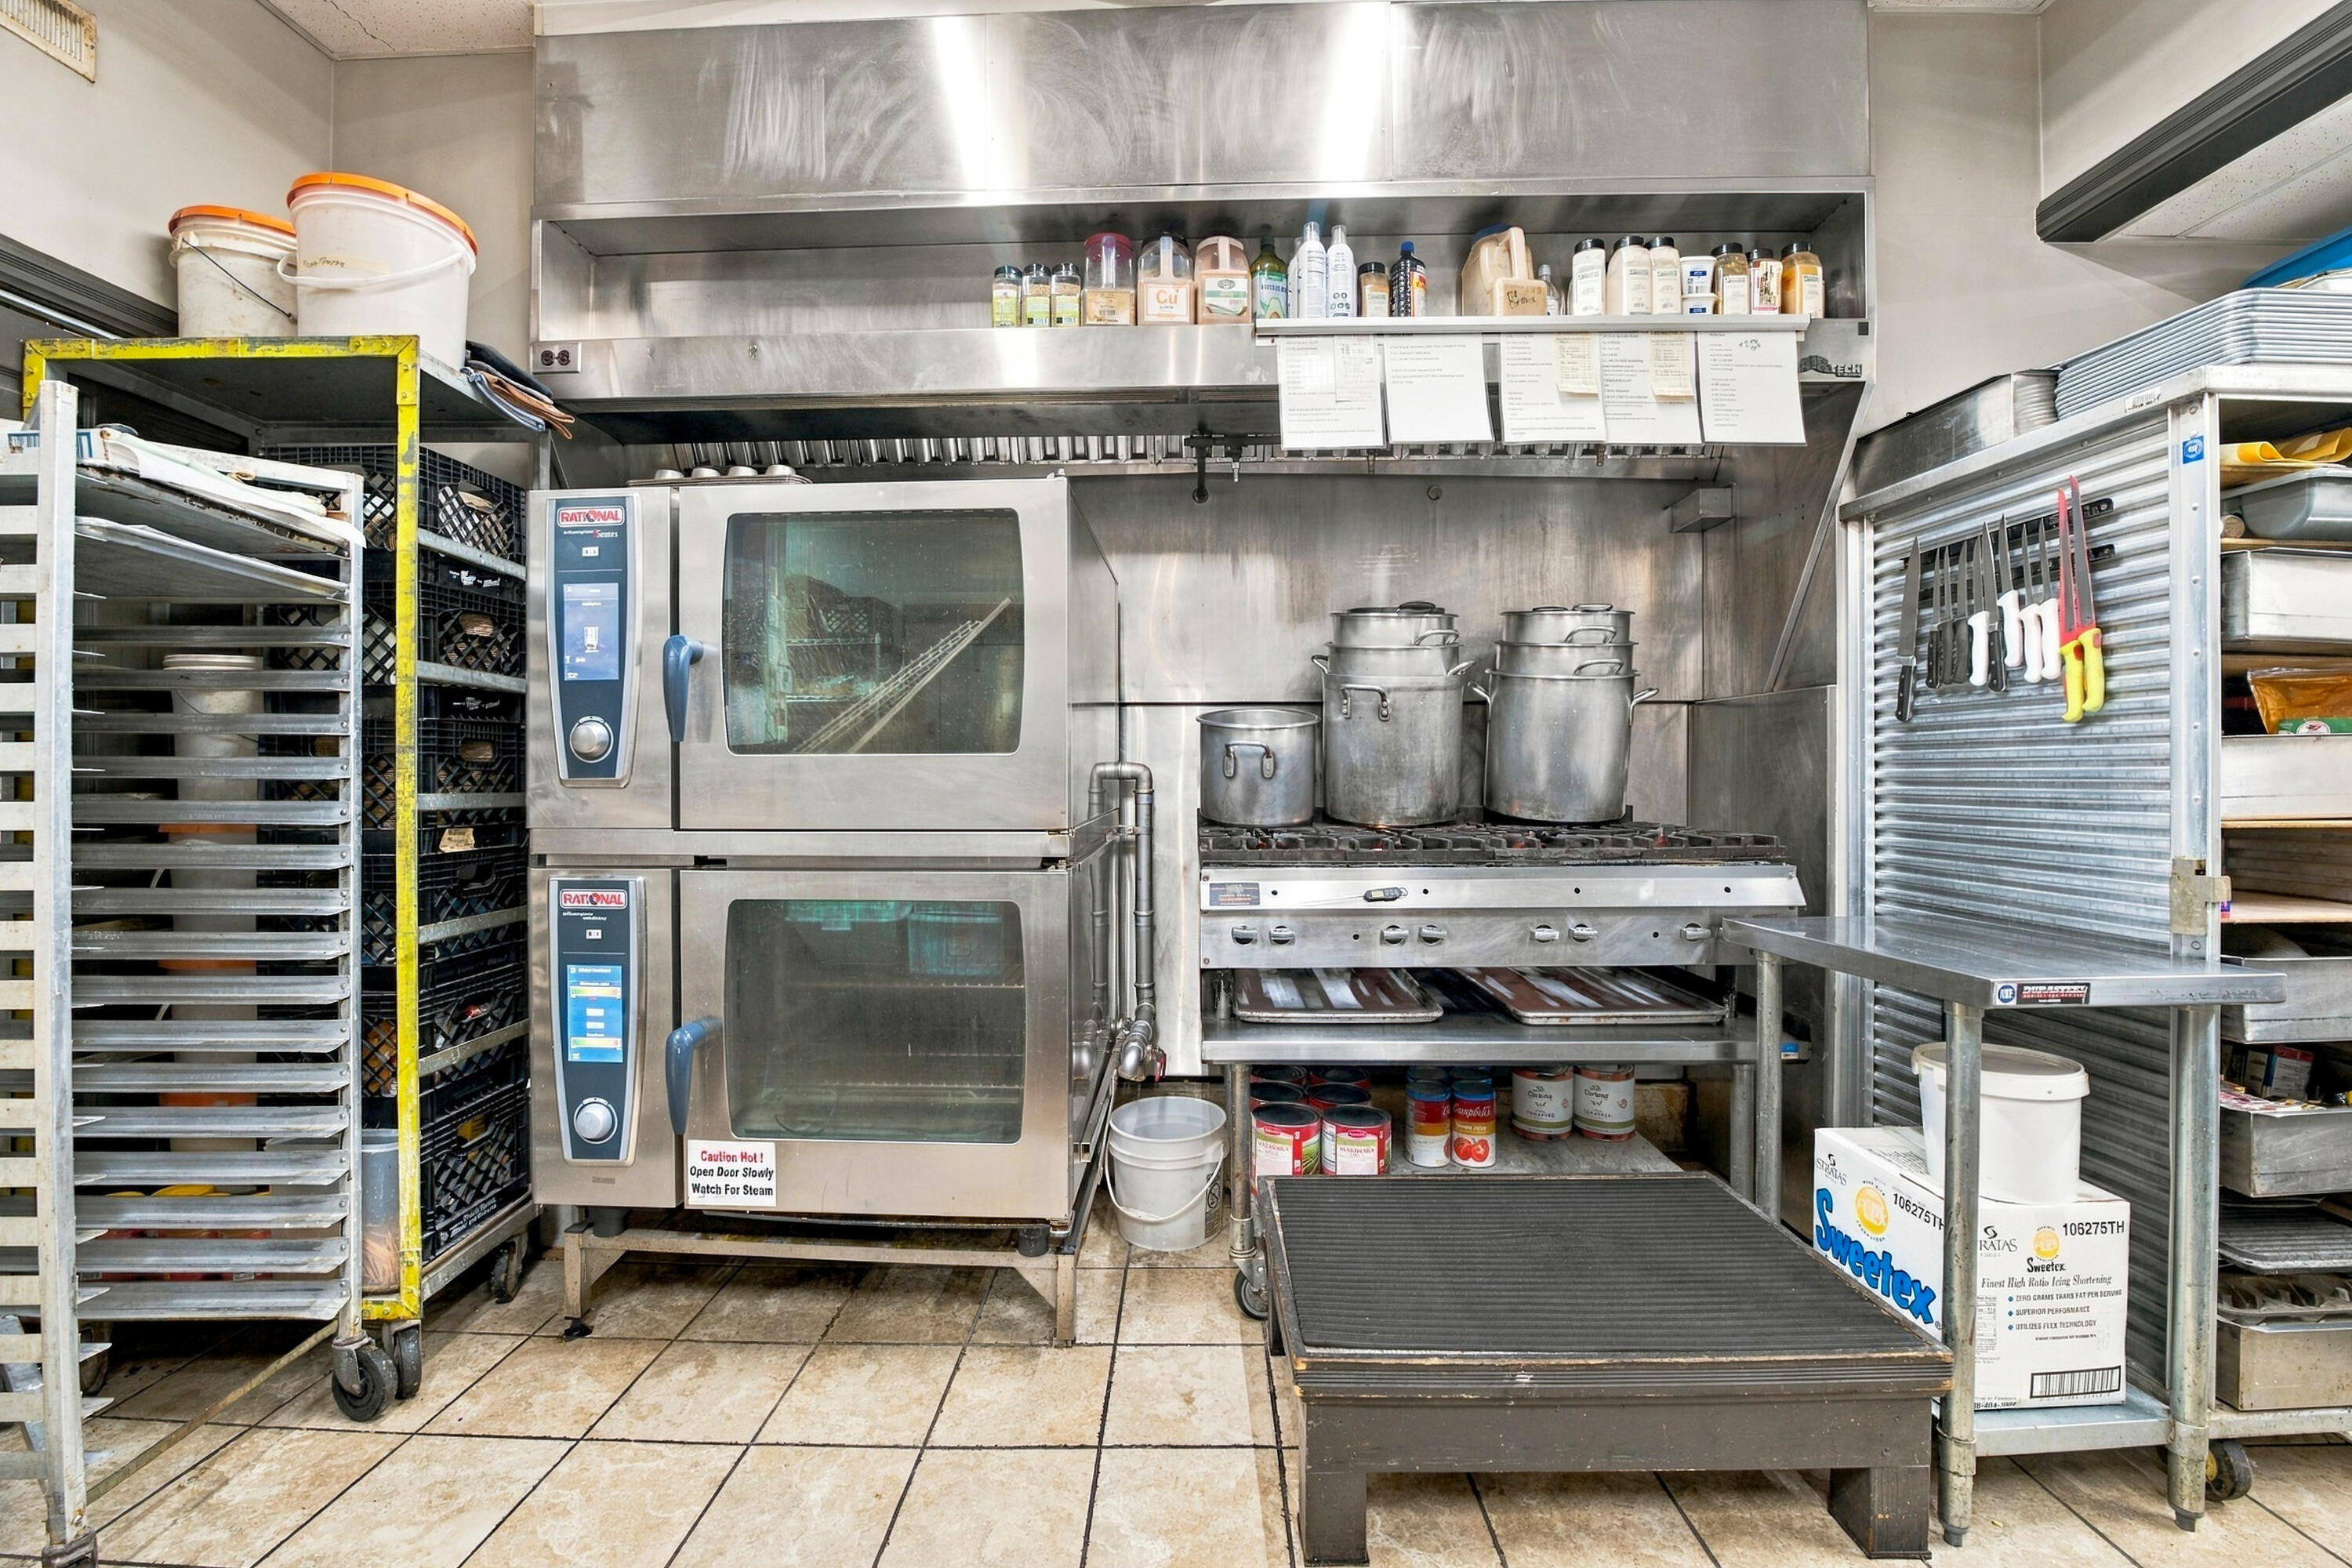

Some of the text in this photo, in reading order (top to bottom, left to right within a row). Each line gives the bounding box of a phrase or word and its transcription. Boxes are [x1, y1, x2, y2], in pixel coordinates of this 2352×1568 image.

[561, 510, 621, 523] RATIONAL
[563, 892, 624, 906] RATIONAL
[1527, 1091, 1552, 1099] Cortona
[701, 1150, 737, 1163] Caution
[740, 1152, 757, 1163] Hot
[690, 1166, 774, 1181] Open Door Slowly
[1817, 1157, 1848, 1186] STRATAS
[691, 1182, 774, 1196] Watch For Steam
[1893, 1192, 1944, 1231] 106275TH
[2062, 1220, 2125, 1237] 106275TH
[1979, 1238, 2018, 1253] RATAS
[1816, 1188, 1936, 1324] Sweetex
[2027, 1258, 2066, 1273] Sweetex
[1981, 1274, 2112, 1289] Finest High Ratio Icing Shortening
[2033, 1293, 2054, 1301] GRAMS
[2100, 1289, 2122, 1298] SERVING
[2016, 1306, 2090, 1316] SUPERIOR PERFORMANCE
[2059, 1319, 2097, 1329] TECHNOLOGY
